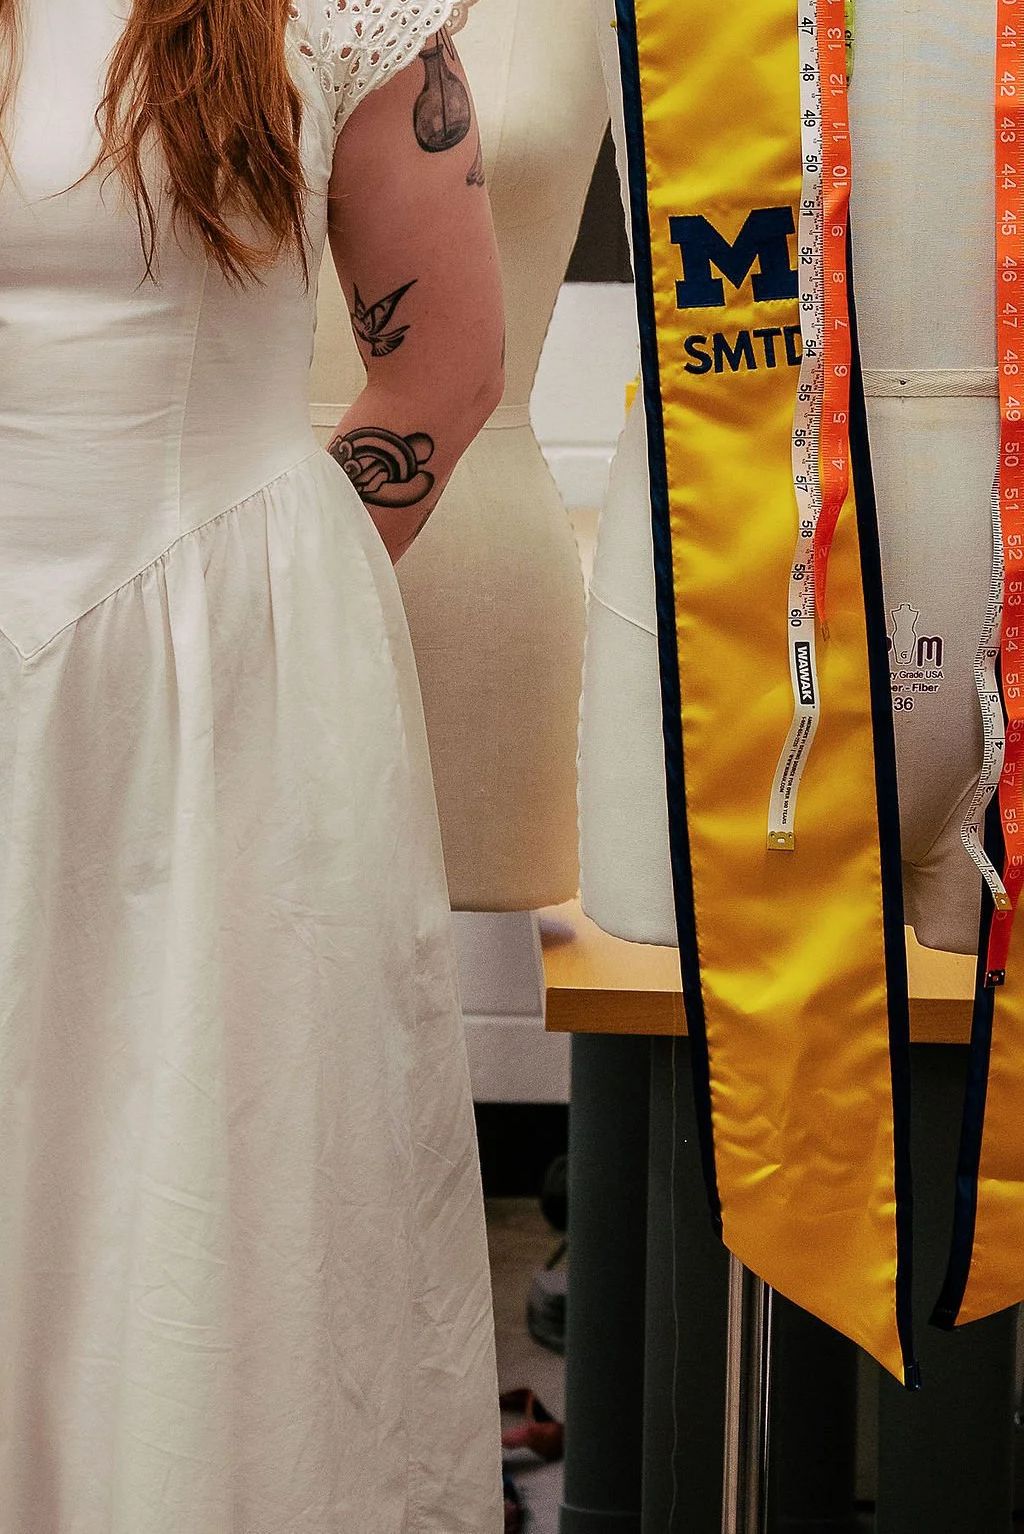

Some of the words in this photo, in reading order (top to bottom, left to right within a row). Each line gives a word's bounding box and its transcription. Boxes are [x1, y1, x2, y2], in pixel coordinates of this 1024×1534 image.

[801, 17, 814, 36] 47
[828, 28, 842, 50] 13
[1002, 26, 1016, 48] 41
[802, 63, 814, 82] 48
[830, 74, 844, 96] 12
[1000, 71, 1016, 96] 42
[804, 110, 816, 128] 49
[833, 122, 846, 142] 11
[1000, 117, 1016, 142] 43
[806, 154, 818, 172] 50
[832, 166, 848, 188] 10
[1002, 164, 1016, 190] 44
[802, 200, 814, 216] 51
[832, 226, 844, 237] 9
[1002, 210, 1016, 236] 45
[668, 206, 798, 309] M
[801, 246, 812, 265] 52
[832, 272, 844, 282] 8
[1002, 256, 1017, 282] 46
[802, 293, 814, 312] 53
[834, 319, 848, 330] 7
[1002, 302, 1017, 328] 47
[805, 339, 816, 358] 54
[834, 366, 848, 377] 6
[1004, 349, 1018, 376] 48
[798, 384, 812, 402] 55
[833, 412, 846, 424] 5
[1005, 396, 1020, 422] 49
[794, 428, 806, 447] 56
[832, 458, 846, 470] 4
[1004, 442, 1020, 467] 50
[796, 475, 808, 492] 57
[1004, 488, 1019, 511] 51
[801, 520, 813, 538] 58
[1008, 534, 1023, 560] 52
[792, 564, 806, 580] 59
[1008, 581, 1022, 606] 53
[791, 609, 802, 627] 60
[1006, 626, 1019, 652] 54
[797, 646, 812, 700] WAWAK
[912, 684, 938, 692] Fiber
[1006, 674, 1020, 698] 55
[894, 697, 914, 710] 36
[990, 694, 998, 702] 5
[1008, 719, 1024, 743] 56
[995, 740, 1004, 750] 4
[1002, 762, 1016, 786] 57
[1004, 808, 1018, 834] 58
